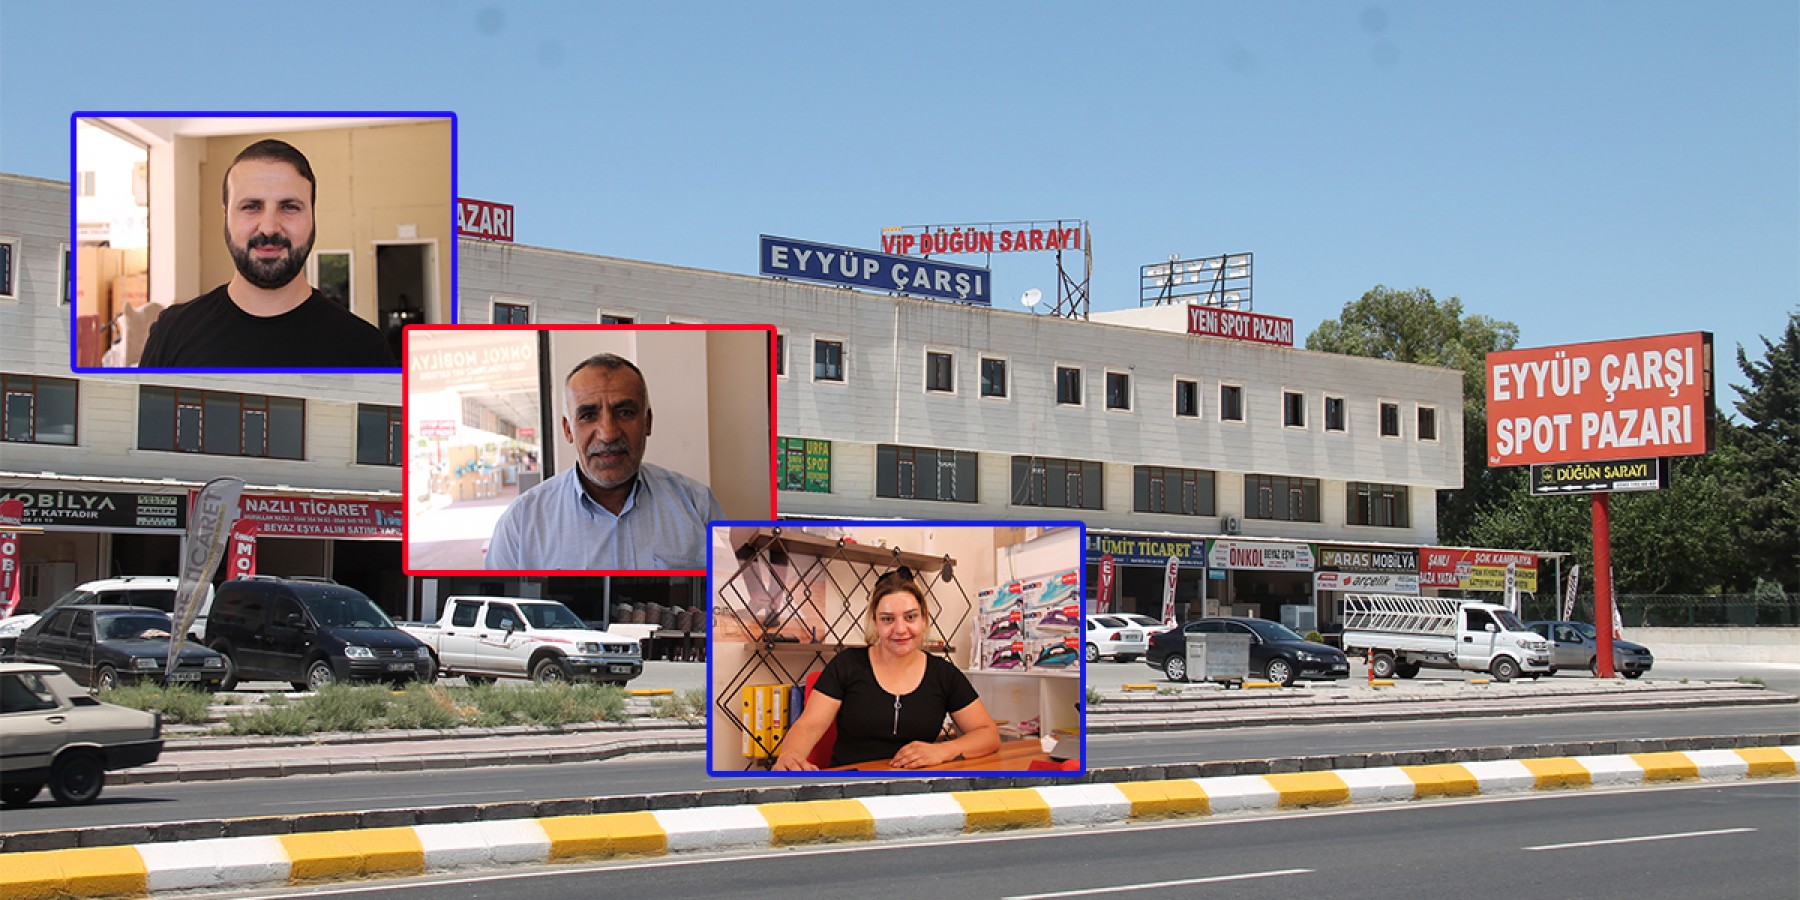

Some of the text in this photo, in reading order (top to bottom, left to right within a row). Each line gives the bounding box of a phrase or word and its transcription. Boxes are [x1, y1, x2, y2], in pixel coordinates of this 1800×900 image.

[458, 200, 512, 238] AZARI
[882, 227, 1081, 254] VİP DÜĞÜN SARAYI
[771, 245, 982, 299] EYYÜP ÇARŞI
[1190, 308, 1292, 343] YENİ SPOT PAZARI
[1493, 347, 1694, 403] EYYÜP ÇARŞI
[1496, 404, 1692, 455] SPOT PAZARI
[806, 441, 828, 454] URFA
[806, 457, 828, 471] SPOT
[1556, 464, 1648, 481] DÜĞÜN SARAYI
[0, 491, 116, 511] OBİLYA
[246, 499, 369, 516] NAZLI TİCARET
[41, 509, 98, 519] KATTADIR
[264, 523, 295, 532] BEYAZ
[298, 524, 320, 534] EŞYA
[324, 525, 345, 534] ALIM
[1102, 537, 1135, 554] ÜMİT
[1138, 538, 1191, 557] TİCARET
[1230, 546, 1264, 567] ÖNKOL
[1333, 552, 1415, 568] ARAS MOBİLYA
[1475, 553, 1491, 565] ŞOK
[1352, 575, 1391, 588] arçelik
